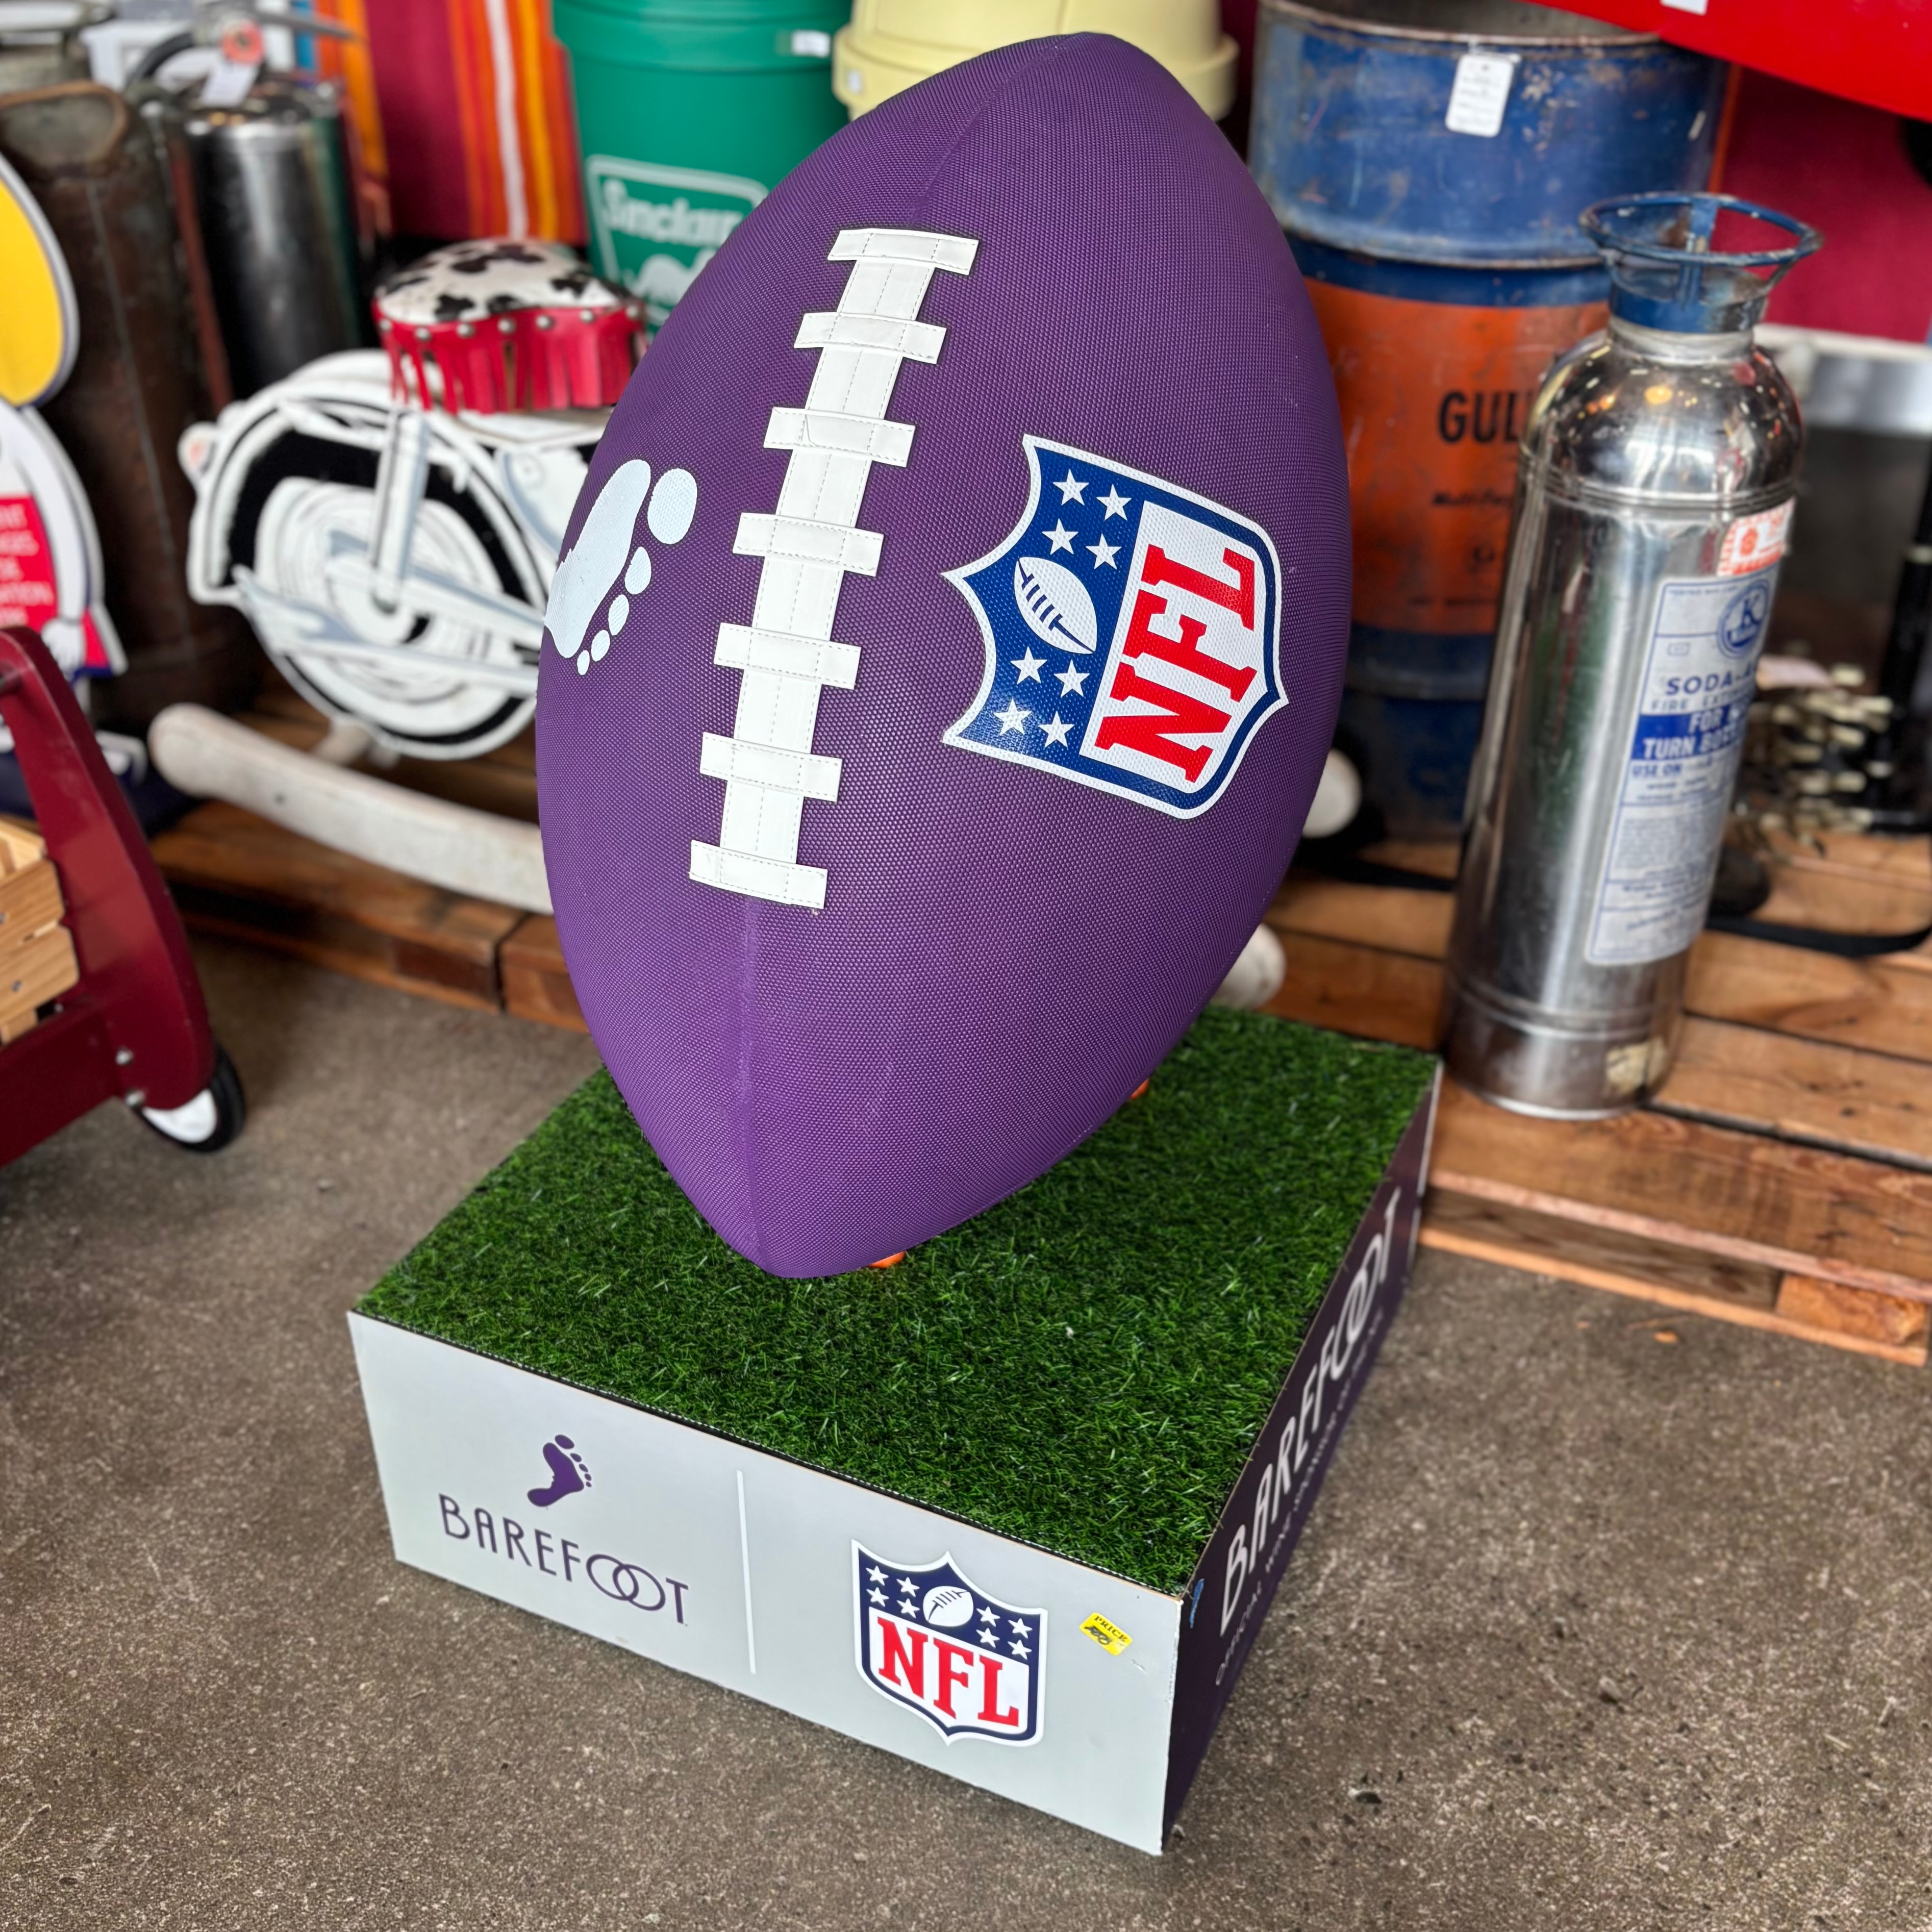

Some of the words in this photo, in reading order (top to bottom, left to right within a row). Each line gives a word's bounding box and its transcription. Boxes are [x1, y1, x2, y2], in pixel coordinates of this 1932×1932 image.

[1438, 391, 1537, 443] GUL
[1094, 544, 1258, 784] NFL
[1643, 735, 1697, 759] TURN
[1219, 1186, 1401, 1637] BAREFOOT
[439, 1493, 689, 1625] BAREFOOT
[877, 1616, 1019, 1727] NFL
[1094, 1615, 1127, 1642] PRICE
